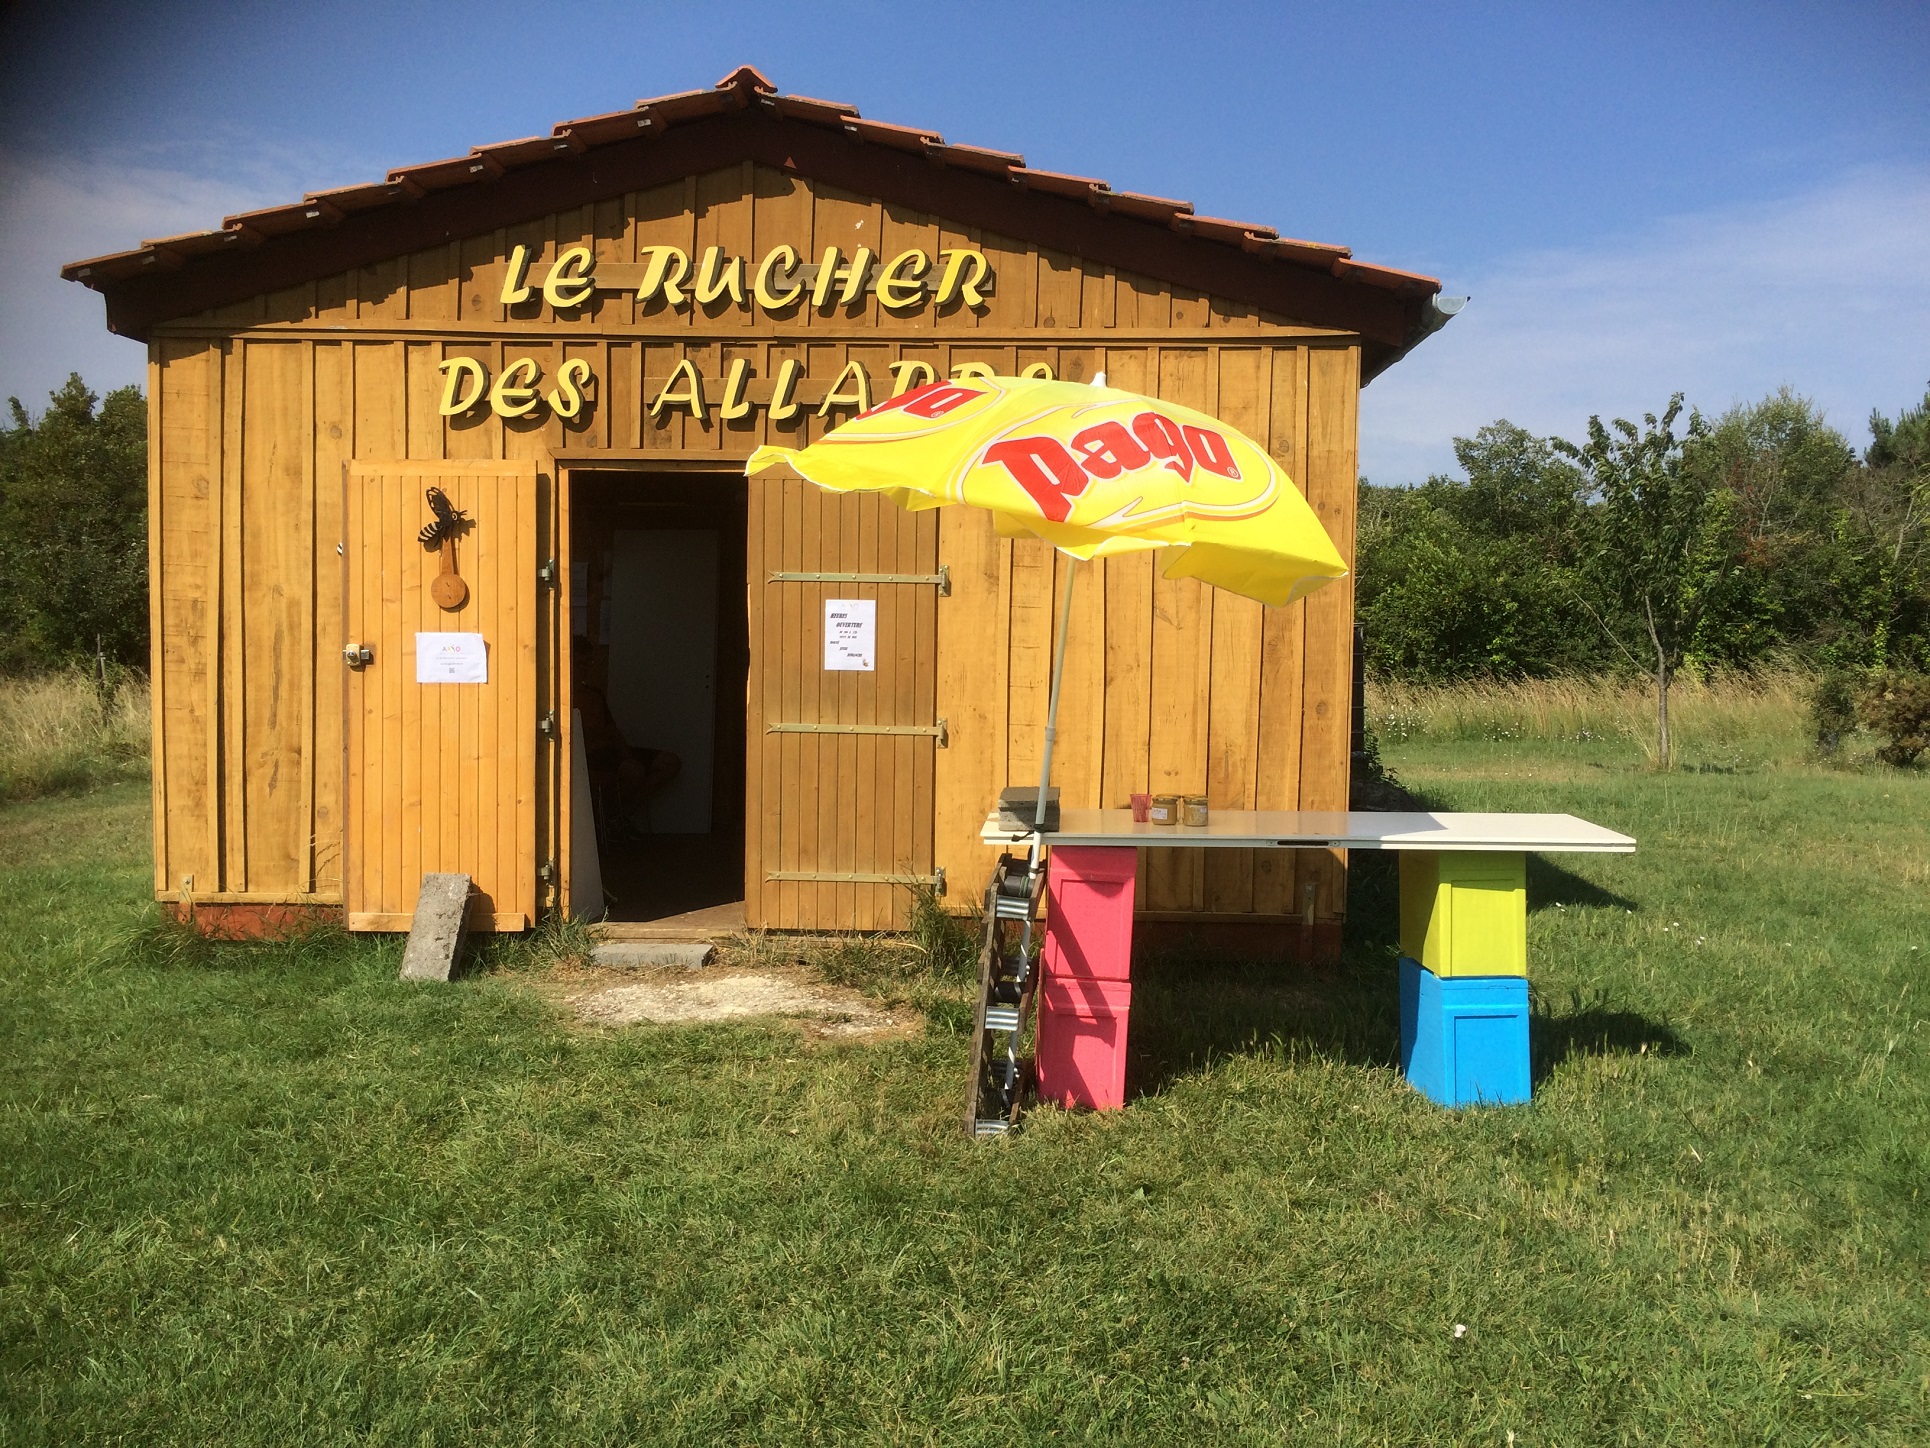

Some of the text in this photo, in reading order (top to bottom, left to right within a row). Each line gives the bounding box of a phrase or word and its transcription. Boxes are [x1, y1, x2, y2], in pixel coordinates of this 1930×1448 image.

[499, 244, 993, 309] LE RUCHER
[438, 356, 597, 418] DES
